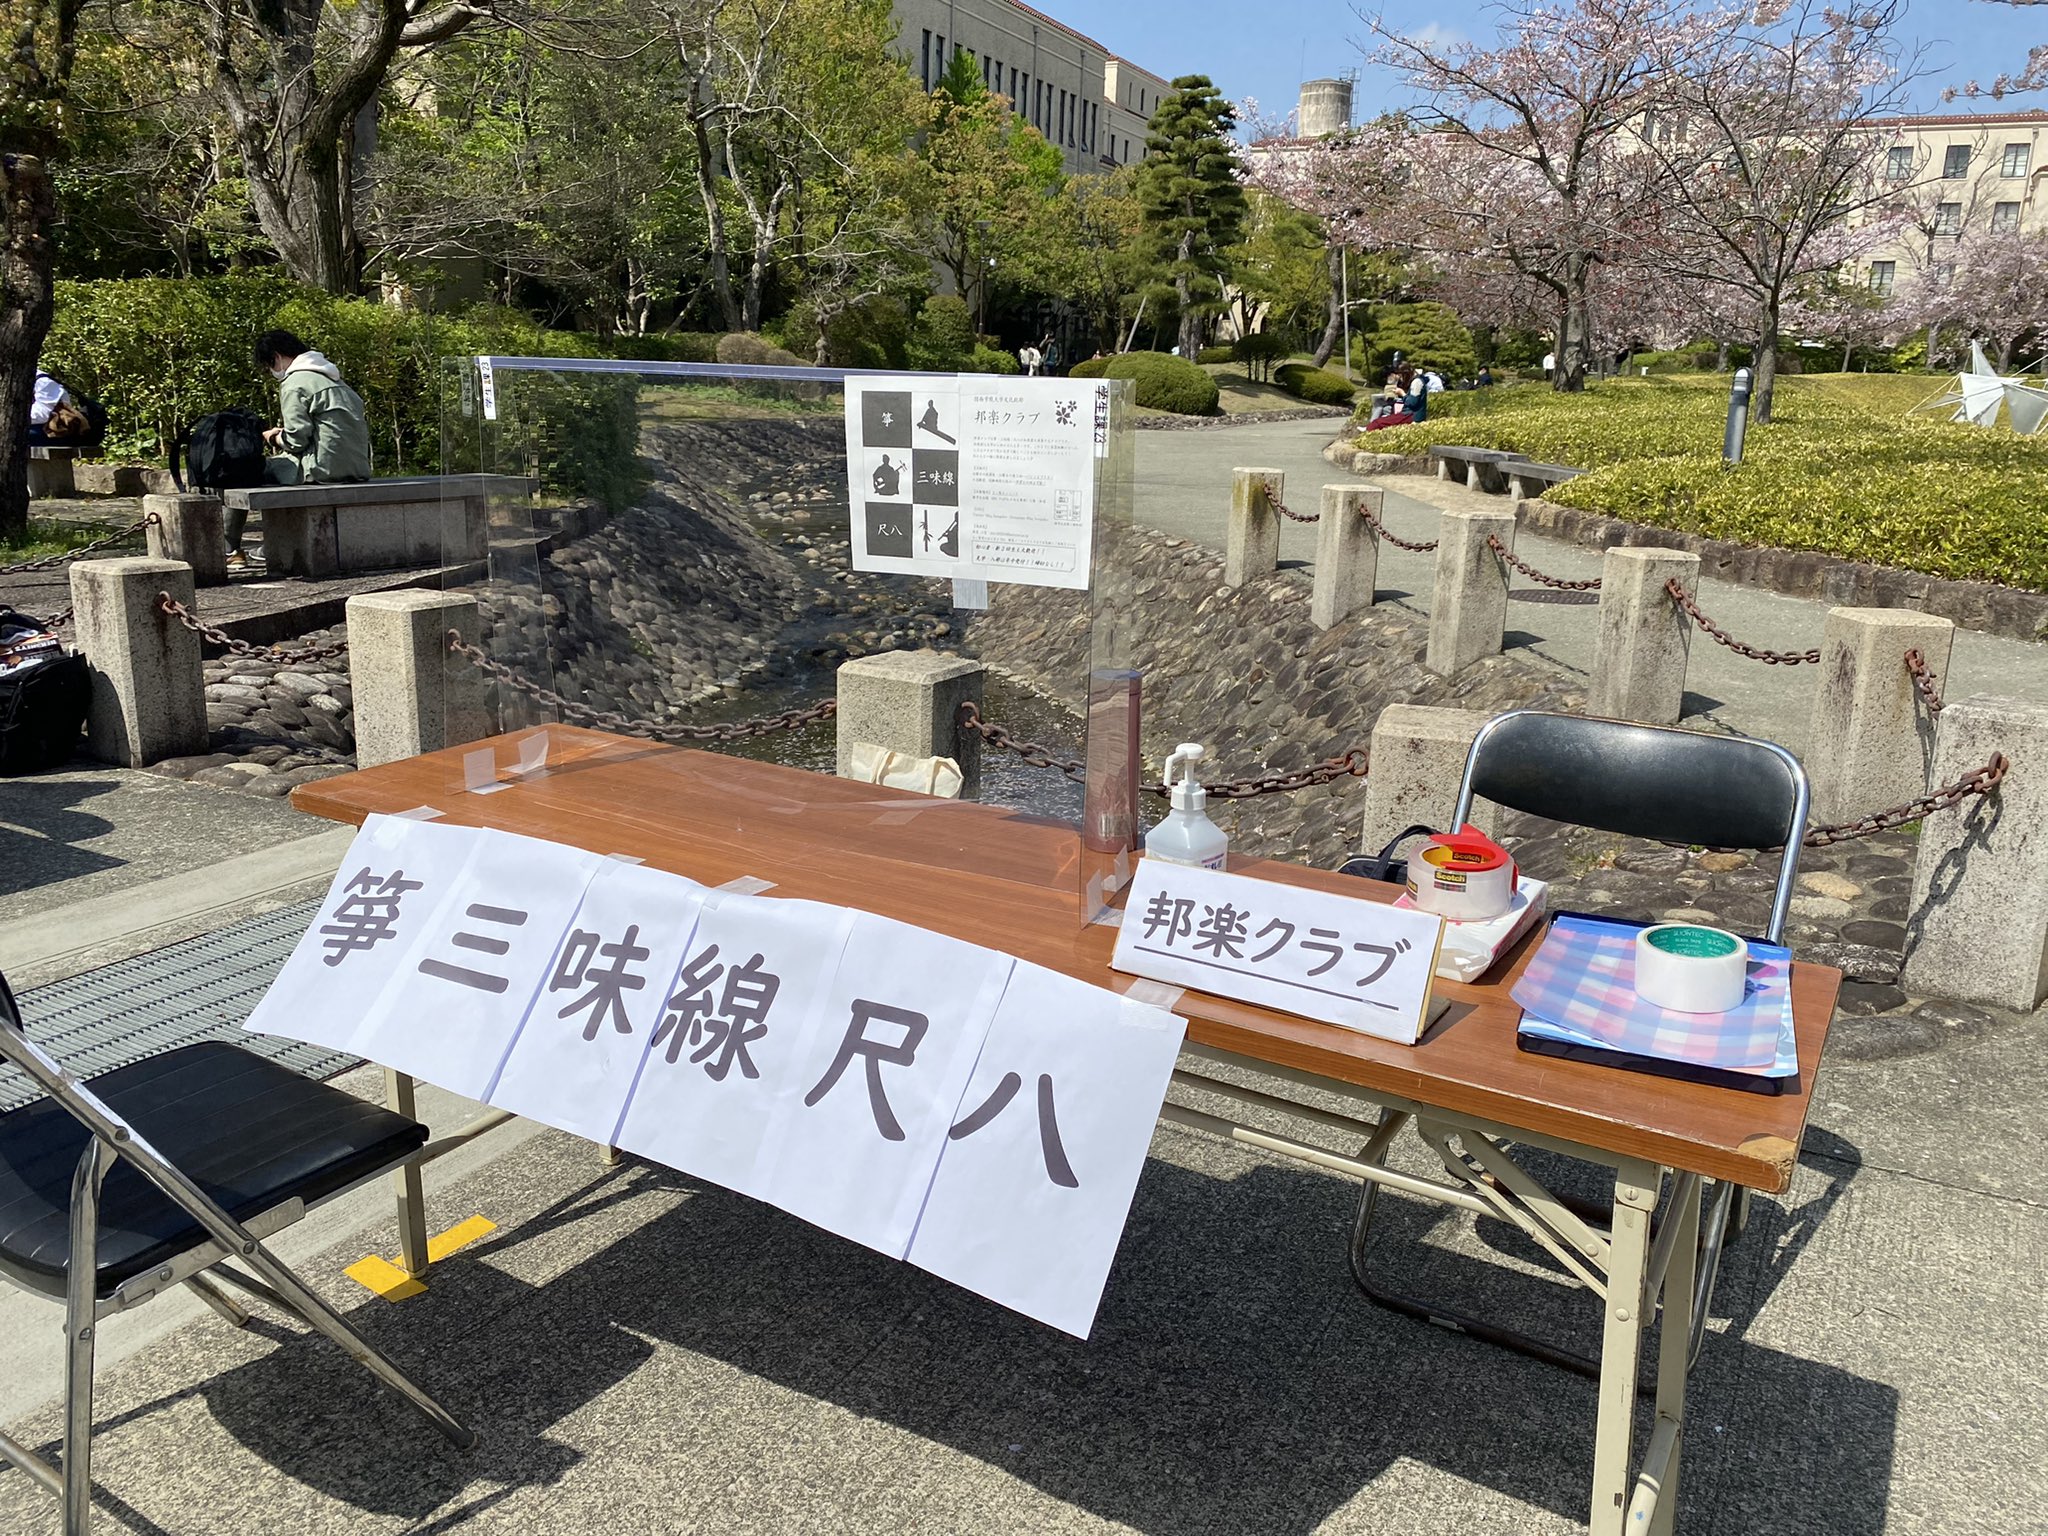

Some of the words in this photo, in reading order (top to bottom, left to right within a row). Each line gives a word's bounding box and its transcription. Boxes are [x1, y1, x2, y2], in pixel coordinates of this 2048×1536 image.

[974, 410, 1041, 425] 邦楽クラブ
[917, 470, 955, 487] 三味線
[877, 523, 903, 536] 尺八
[1453, 853, 1480, 862] Scotch
[1436, 872, 1465, 882] Scotch
[1142, 890, 1412, 987] 邦楽クラブ
